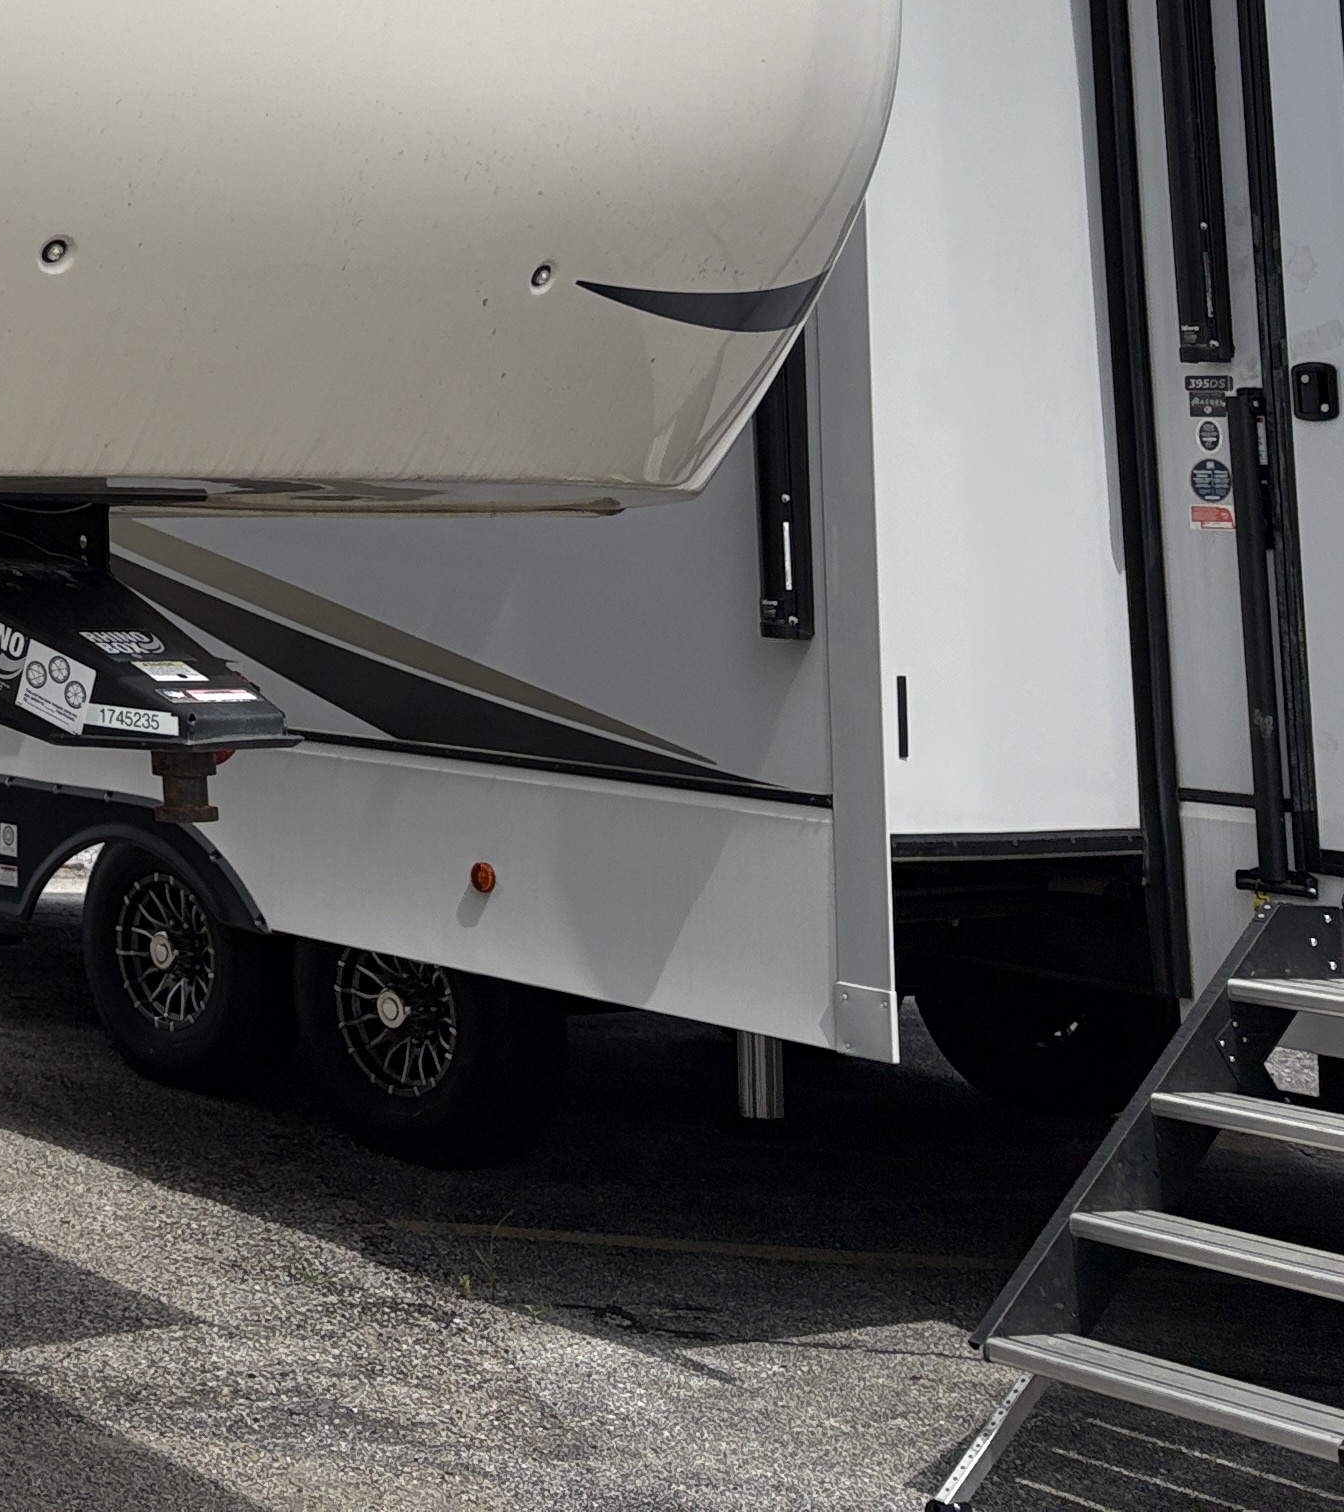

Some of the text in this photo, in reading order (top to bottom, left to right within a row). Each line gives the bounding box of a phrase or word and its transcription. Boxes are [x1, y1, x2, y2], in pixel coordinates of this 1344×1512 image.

[1188, 378, 1226, 389] 395DS
[79, 631, 151, 644] RHINO
[95, 642, 150, 655] BOX
[99, 707, 160, 731] 1745235
